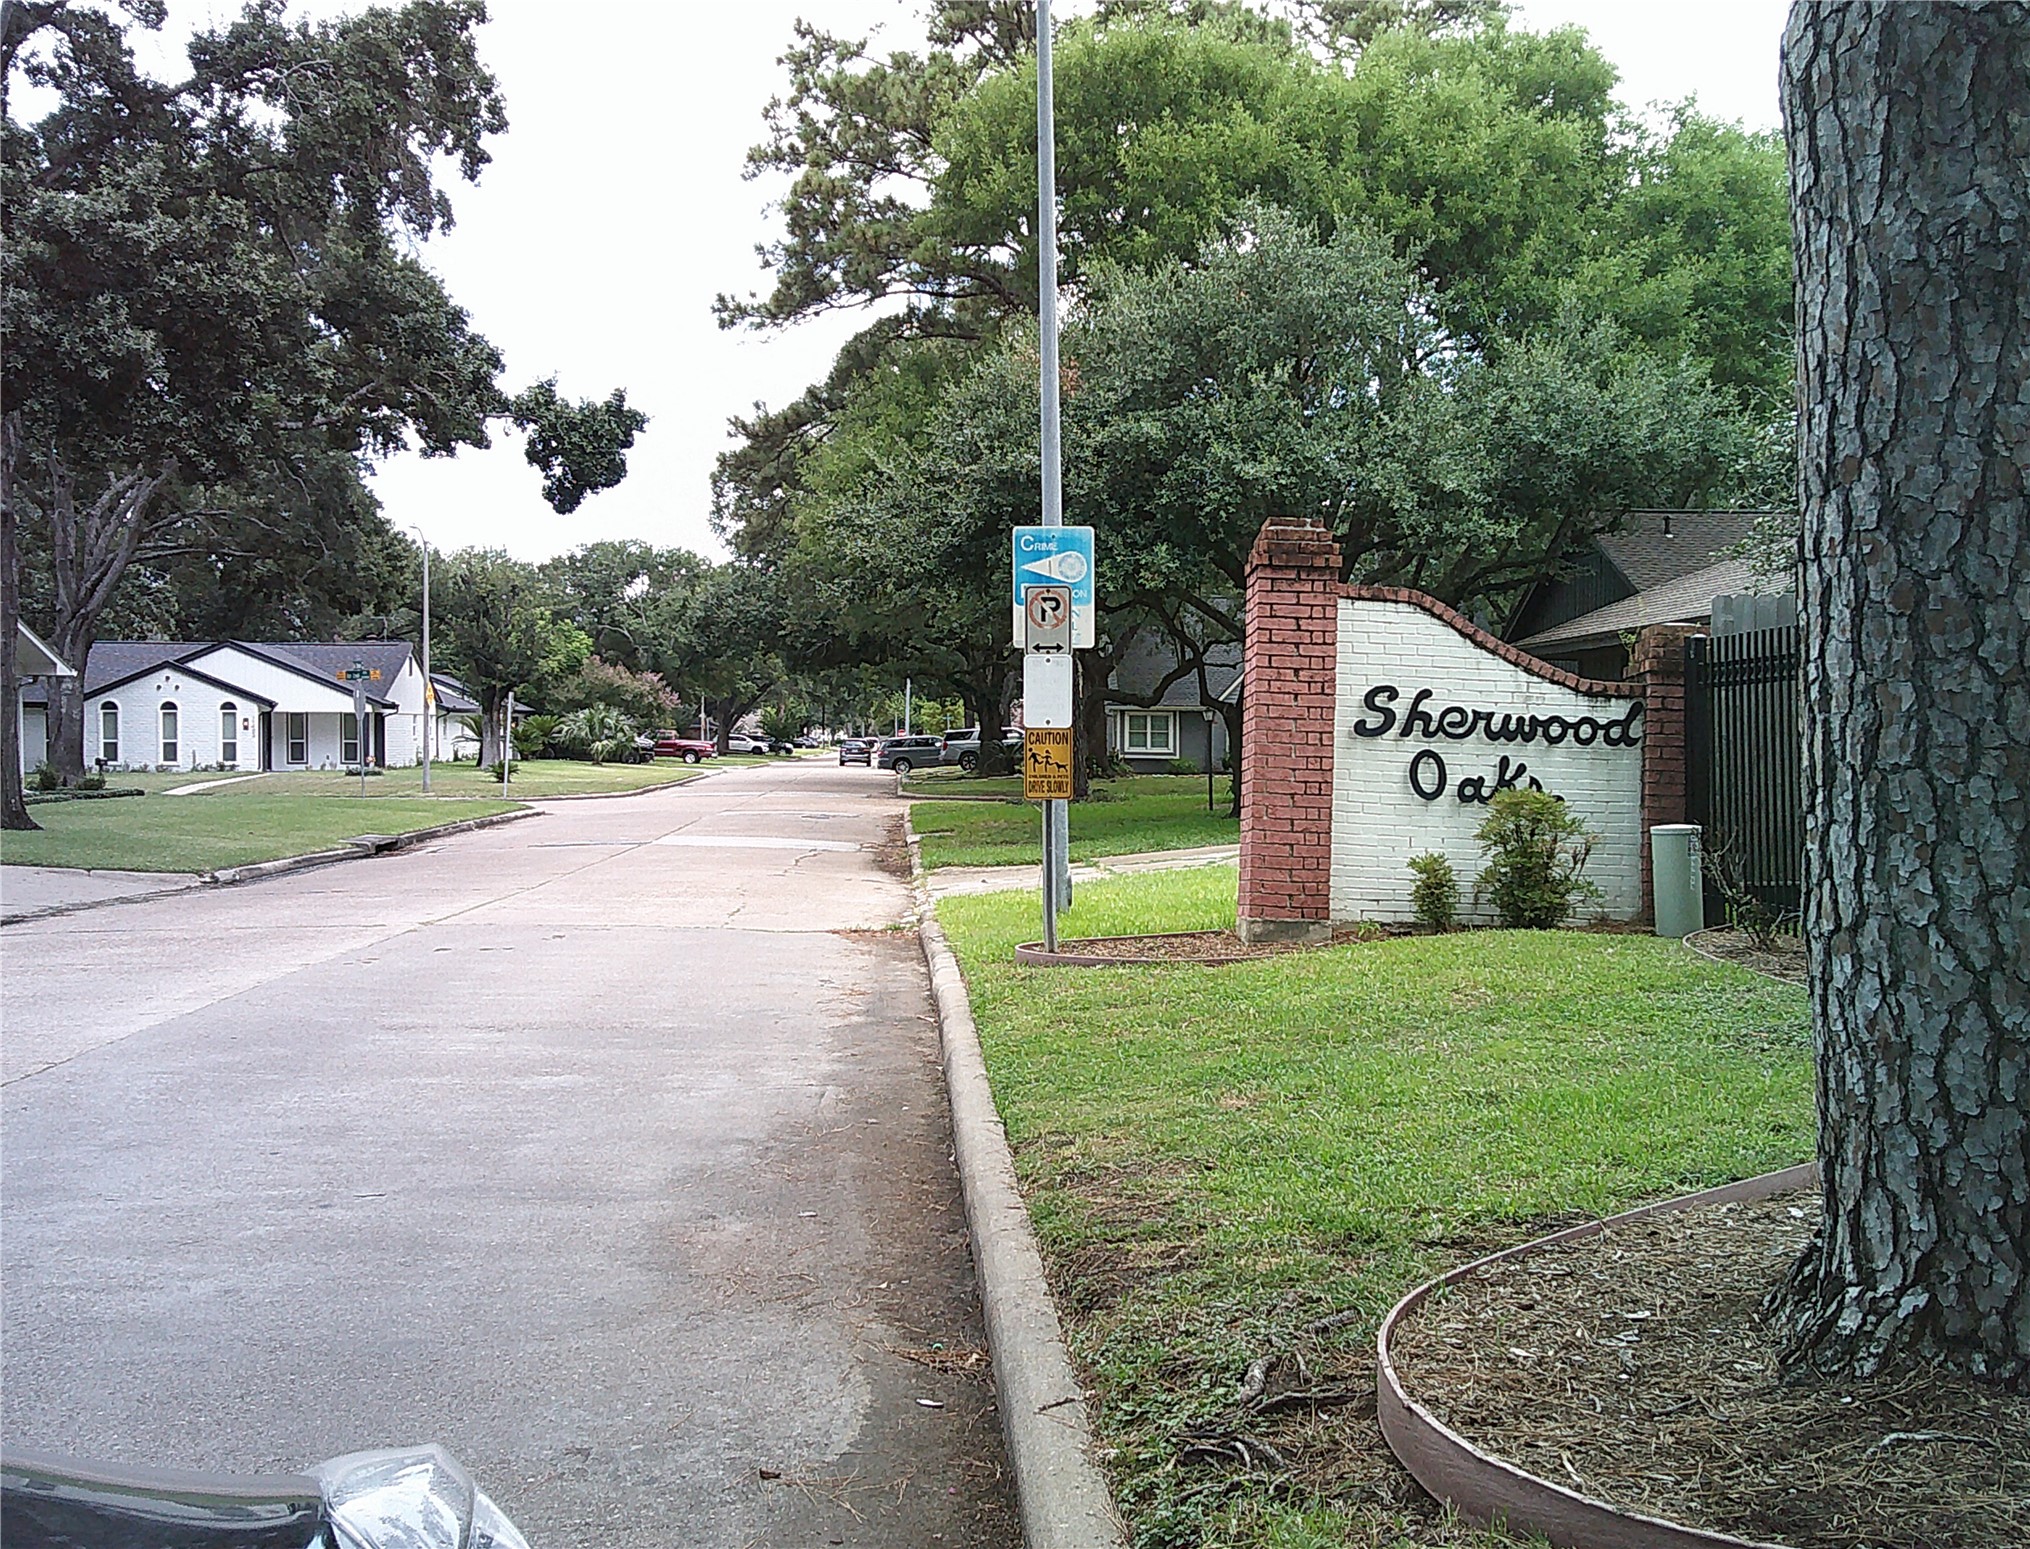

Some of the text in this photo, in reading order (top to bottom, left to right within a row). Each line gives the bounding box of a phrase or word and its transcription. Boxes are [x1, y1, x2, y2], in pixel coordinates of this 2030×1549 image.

[1020, 535, 1059, 551] CRIME
[1353, 684, 1645, 748] Sherwood
[1028, 732, 1069, 745] CAUTION
[1028, 780, 1069, 793] DRIVE SLOWLY
